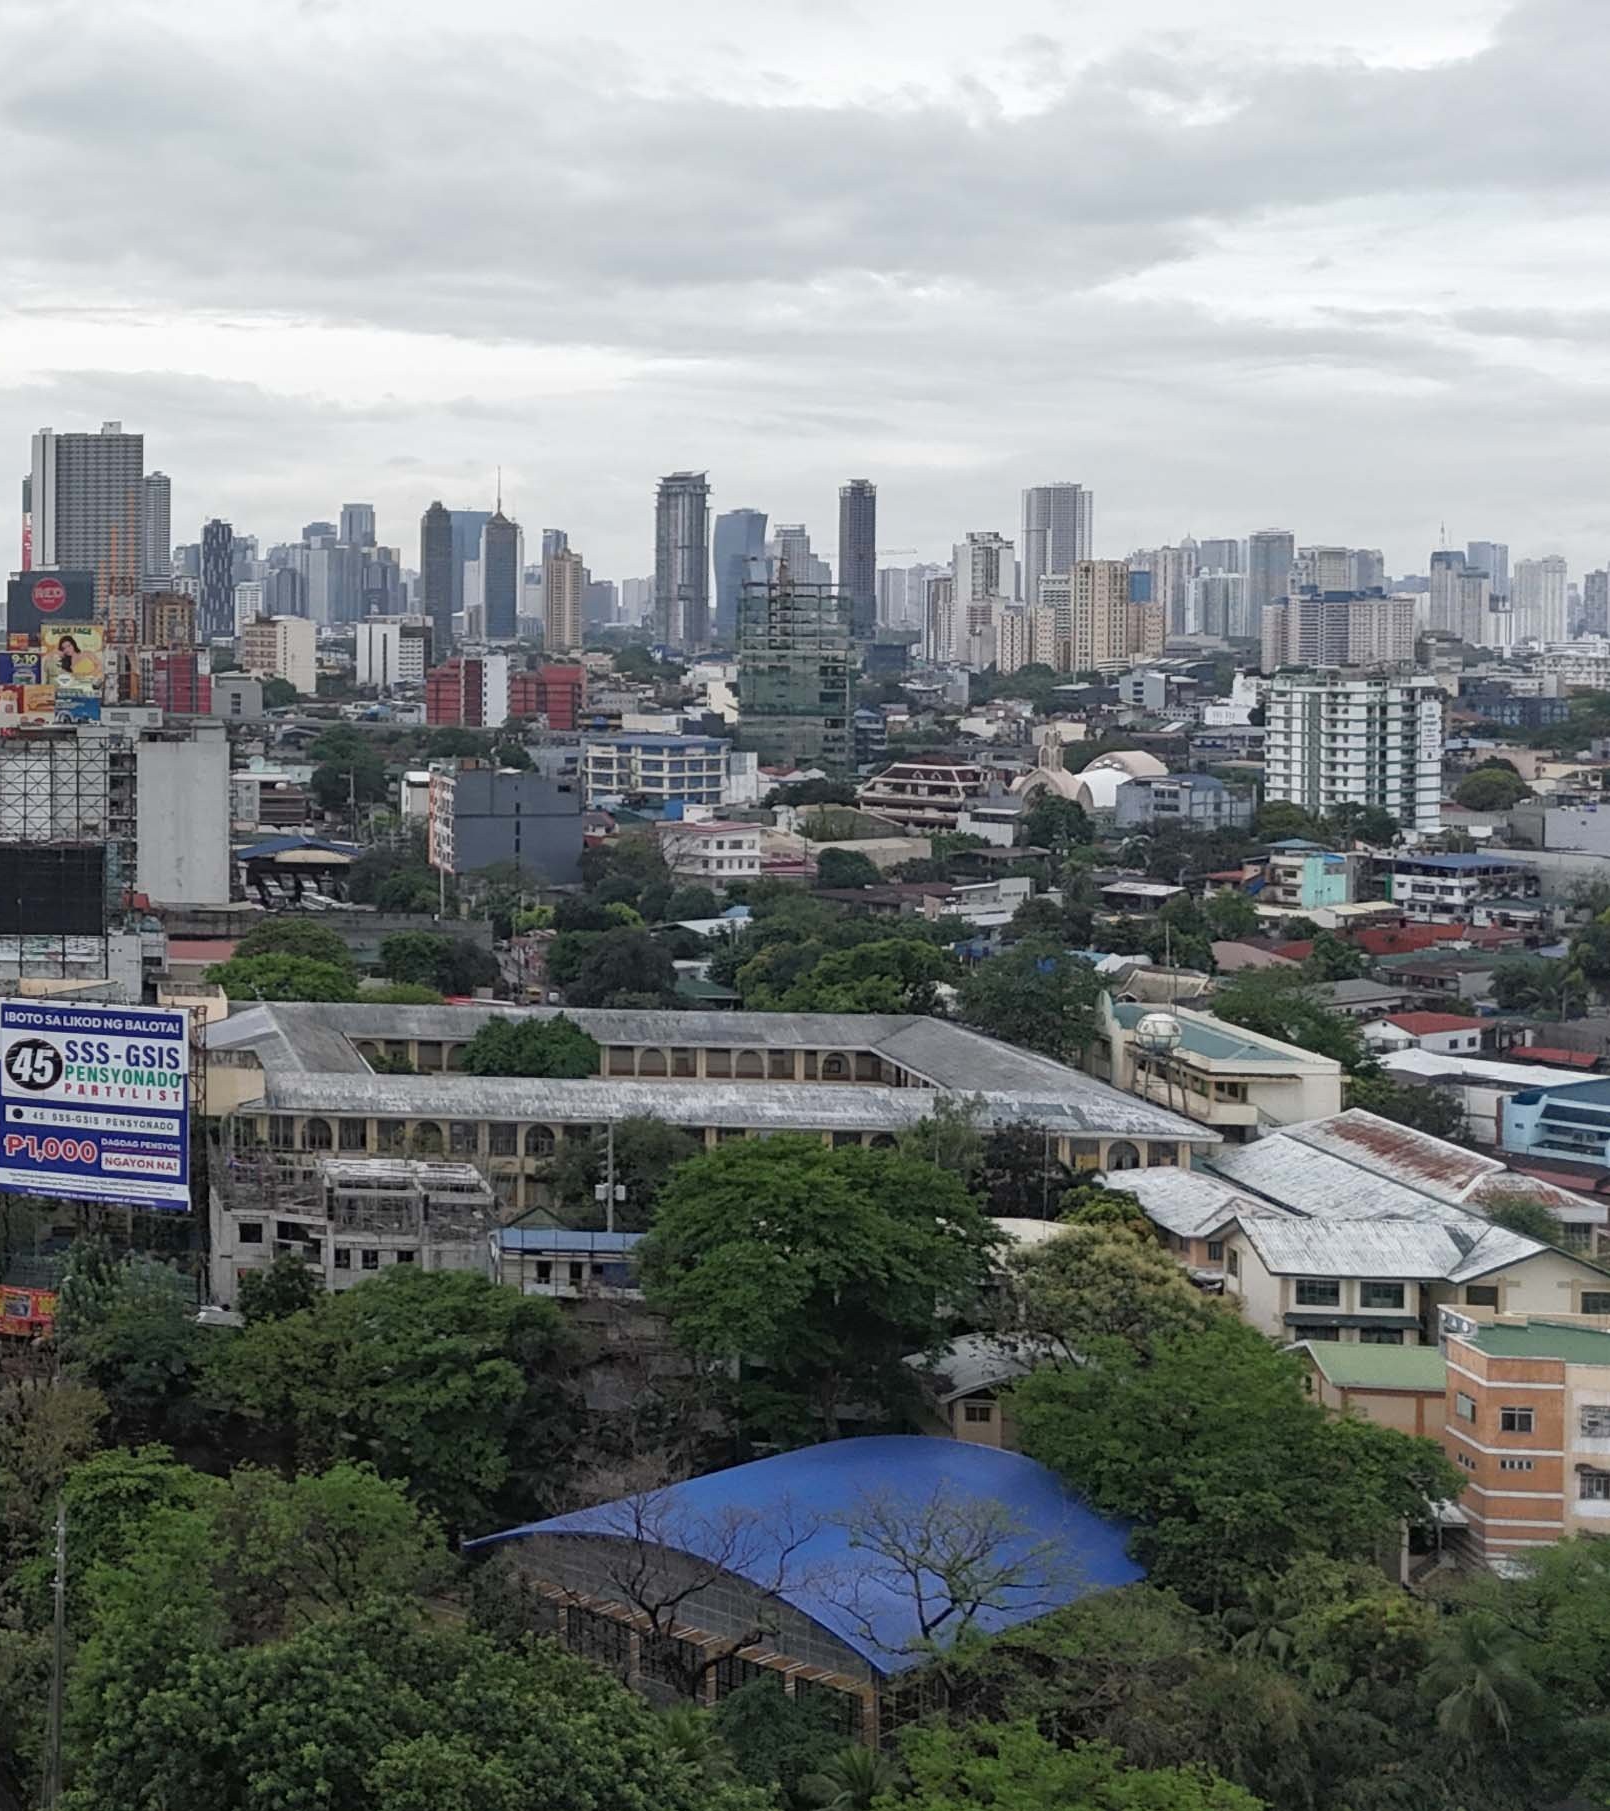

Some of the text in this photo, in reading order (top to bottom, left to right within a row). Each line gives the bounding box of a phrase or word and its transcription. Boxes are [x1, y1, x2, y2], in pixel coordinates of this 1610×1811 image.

[4, 1011, 180, 1034] IBOTO SA LIKOD NG BALOTA!
[11, 1047, 55, 1083] 45
[64, 1065, 181, 1089] PENSYONADO
[64, 1083, 182, 1102] PARTYLIST
[105, 1117, 174, 1131] PENSYONADO
[104, 1157, 177, 1171] NGAYON NA!
